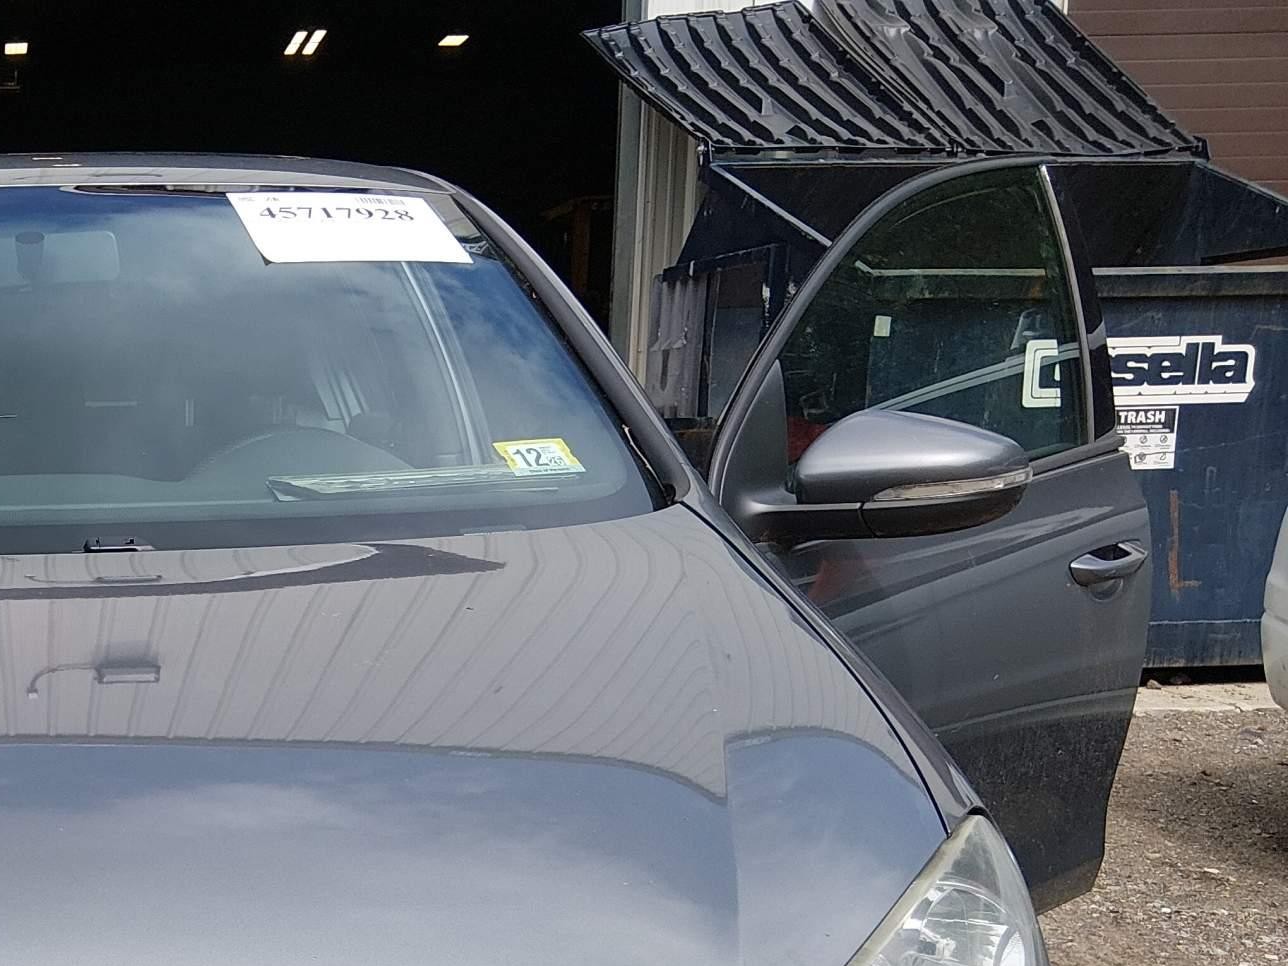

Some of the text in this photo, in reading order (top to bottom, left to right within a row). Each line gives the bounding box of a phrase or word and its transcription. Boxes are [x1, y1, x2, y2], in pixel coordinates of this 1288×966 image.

[259, 206, 415, 221] 45717928
[1118, 410, 1166, 424] TRASH
[512, 447, 550, 467] 12
